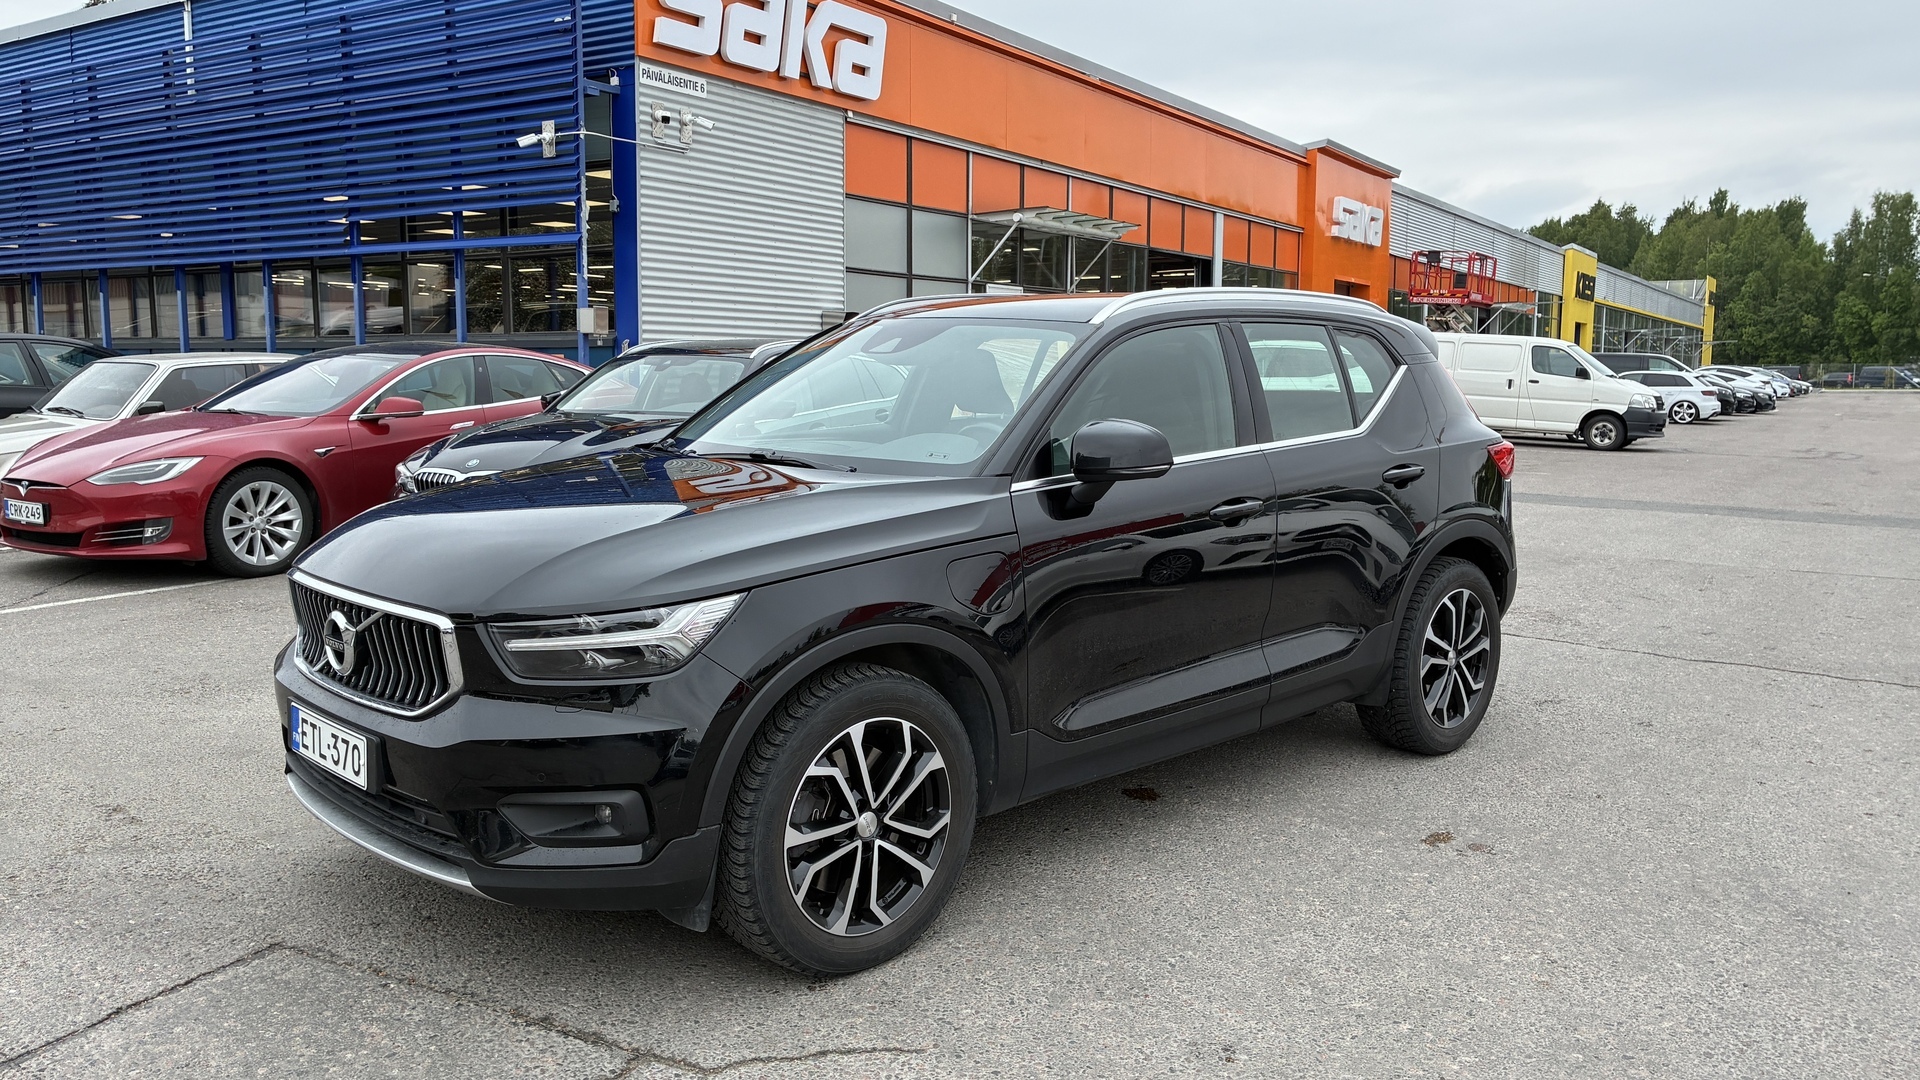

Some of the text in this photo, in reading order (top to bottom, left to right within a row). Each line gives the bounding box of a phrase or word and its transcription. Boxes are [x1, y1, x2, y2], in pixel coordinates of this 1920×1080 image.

[641, 67, 705, 93] PÄIVÄLÄISENTIE 6
[10, 503, 41, 520] CRK-249
[326, 638, 343, 650] VOLVO
[301, 717, 361, 777] ETL-370
